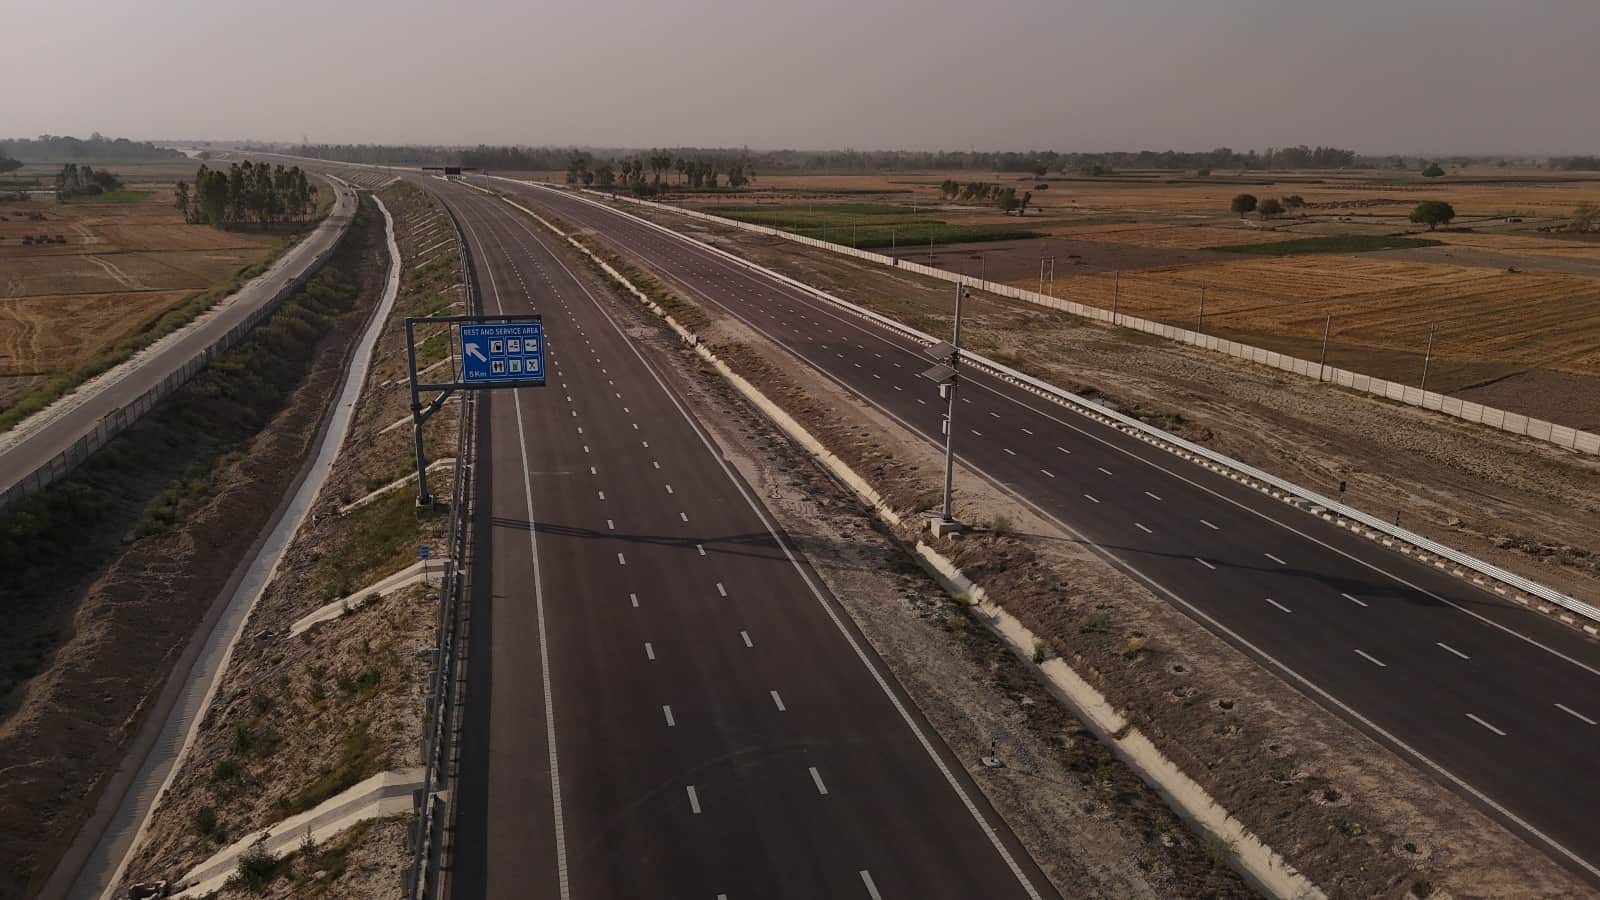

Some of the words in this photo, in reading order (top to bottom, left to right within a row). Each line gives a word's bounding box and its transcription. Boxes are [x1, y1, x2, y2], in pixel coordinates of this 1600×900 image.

[480, 328, 494, 336] AND
[495, 327, 521, 335] SERVICE
[522, 327, 539, 335] AREA
